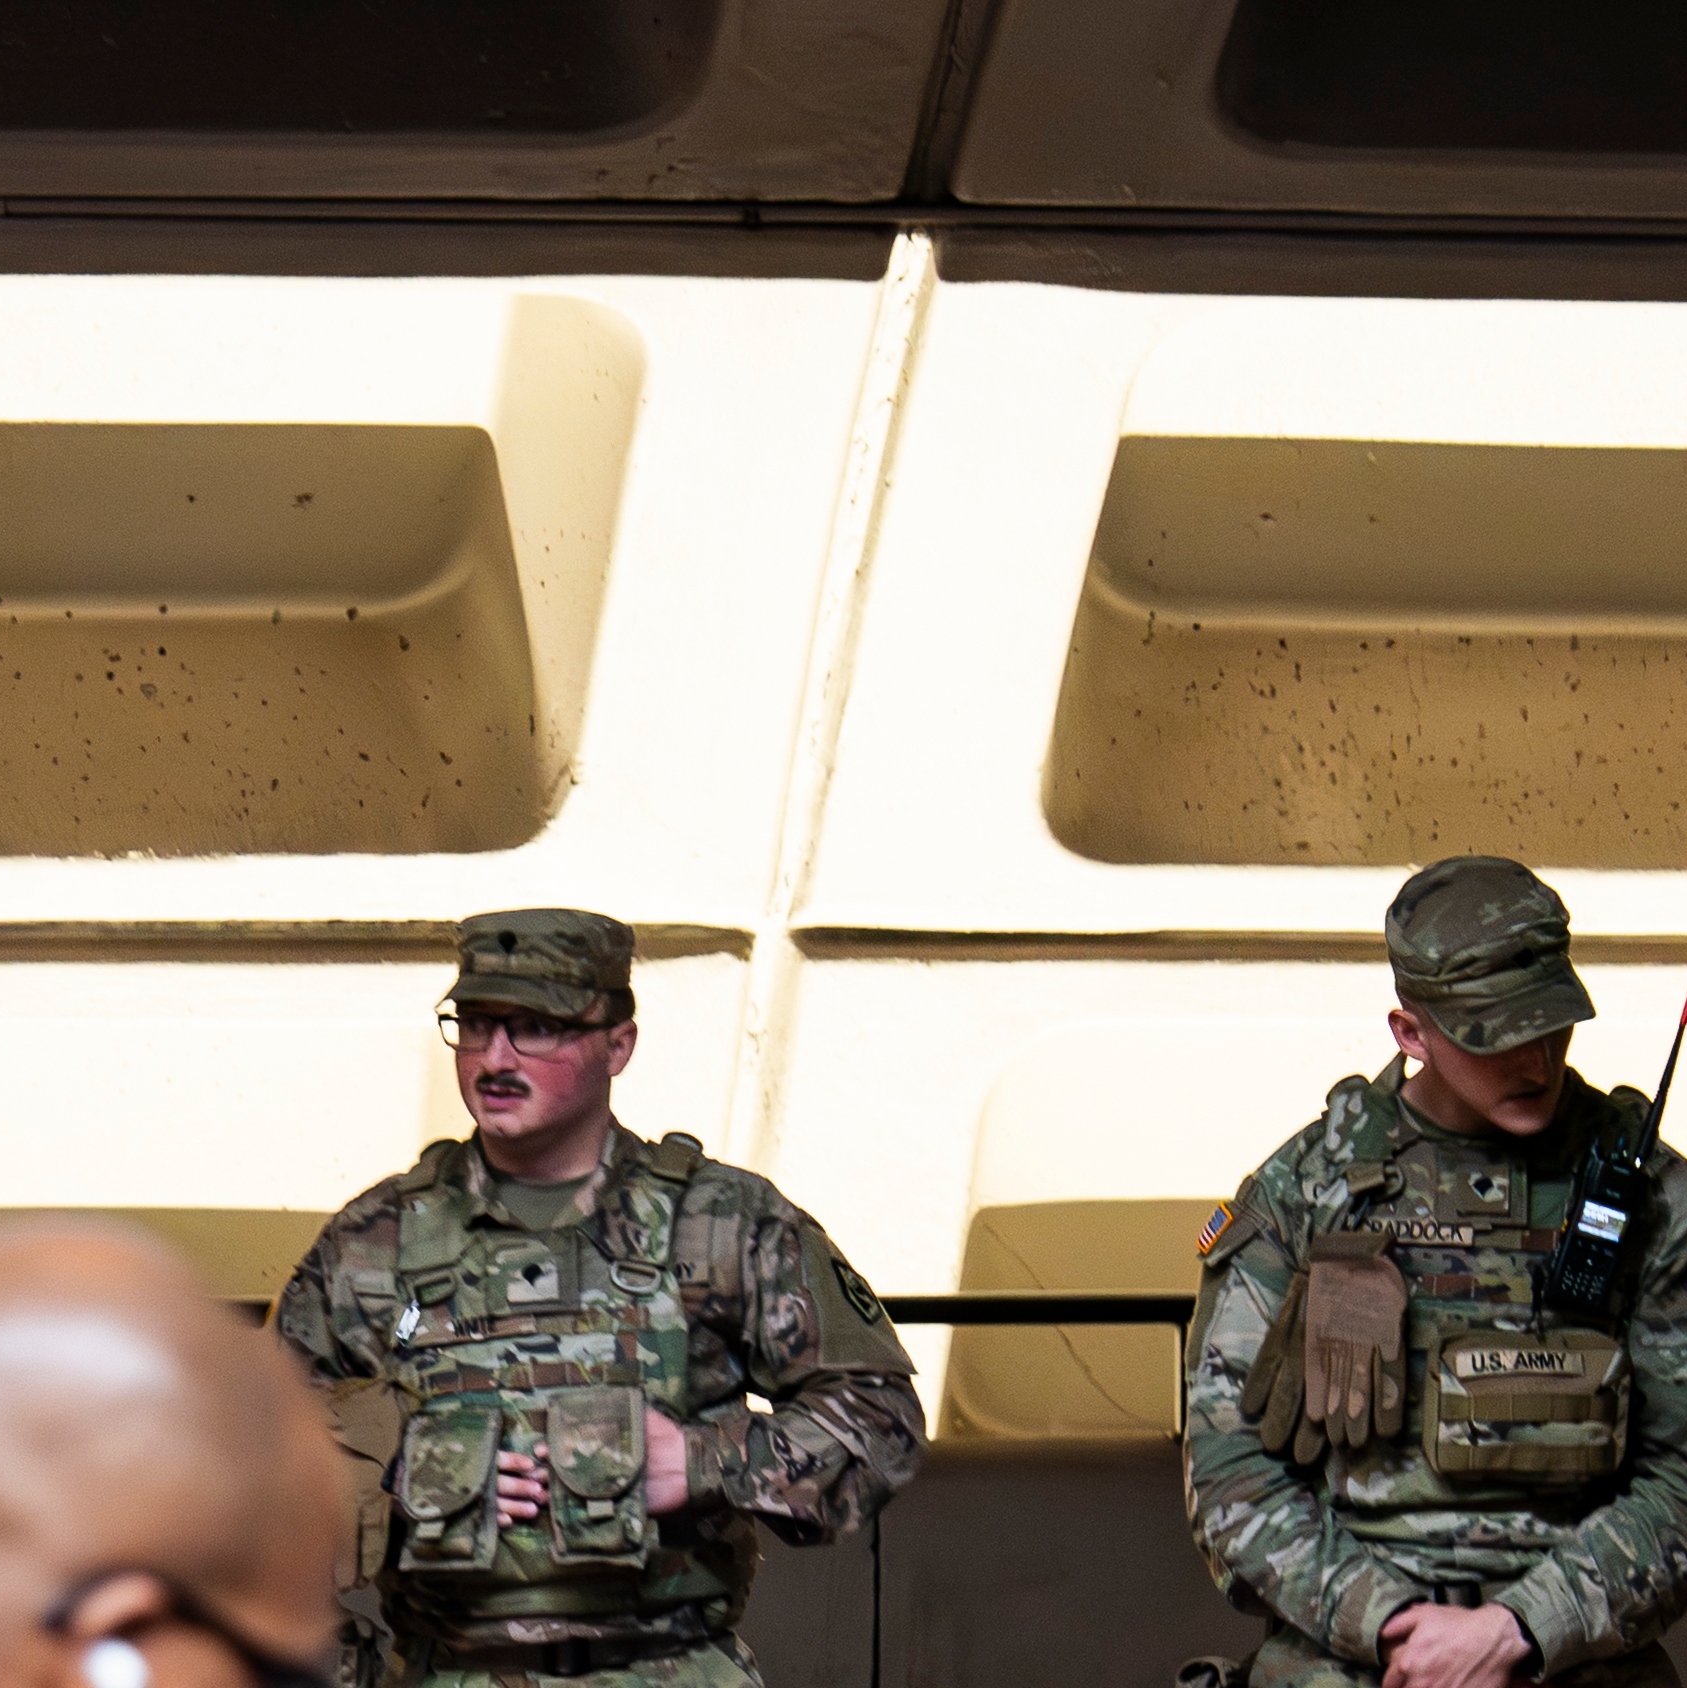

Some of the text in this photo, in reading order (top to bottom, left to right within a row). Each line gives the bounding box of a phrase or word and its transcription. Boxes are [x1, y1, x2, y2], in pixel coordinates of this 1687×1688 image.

[1360, 1219, 1463, 1242] RADDOCK
[1472, 1351, 1566, 1372] U.S. ARMY
